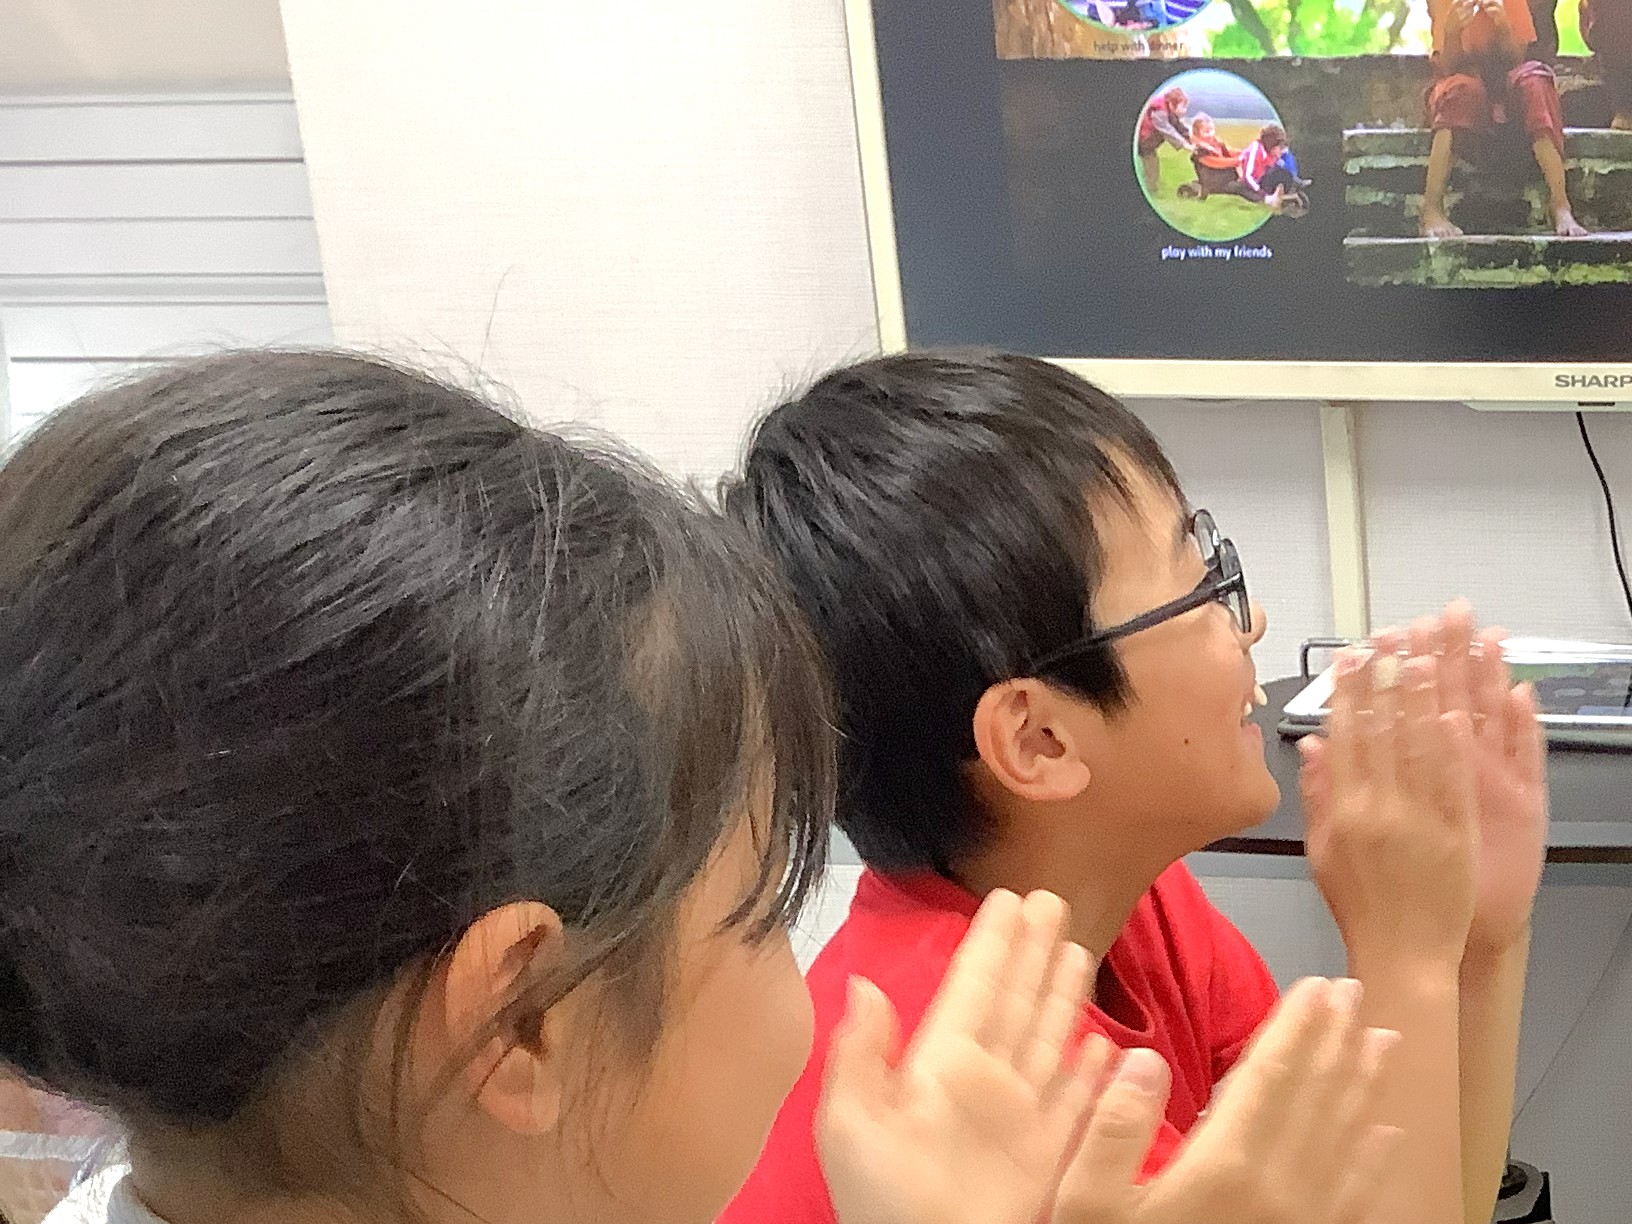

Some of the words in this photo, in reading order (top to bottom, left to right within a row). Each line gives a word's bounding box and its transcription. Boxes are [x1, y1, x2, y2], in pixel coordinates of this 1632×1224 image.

[1161, 245, 1186, 260] play
[1188, 245, 1213, 257] with
[1215, 248, 1232, 260] my
[1234, 245, 1273, 258] friends
